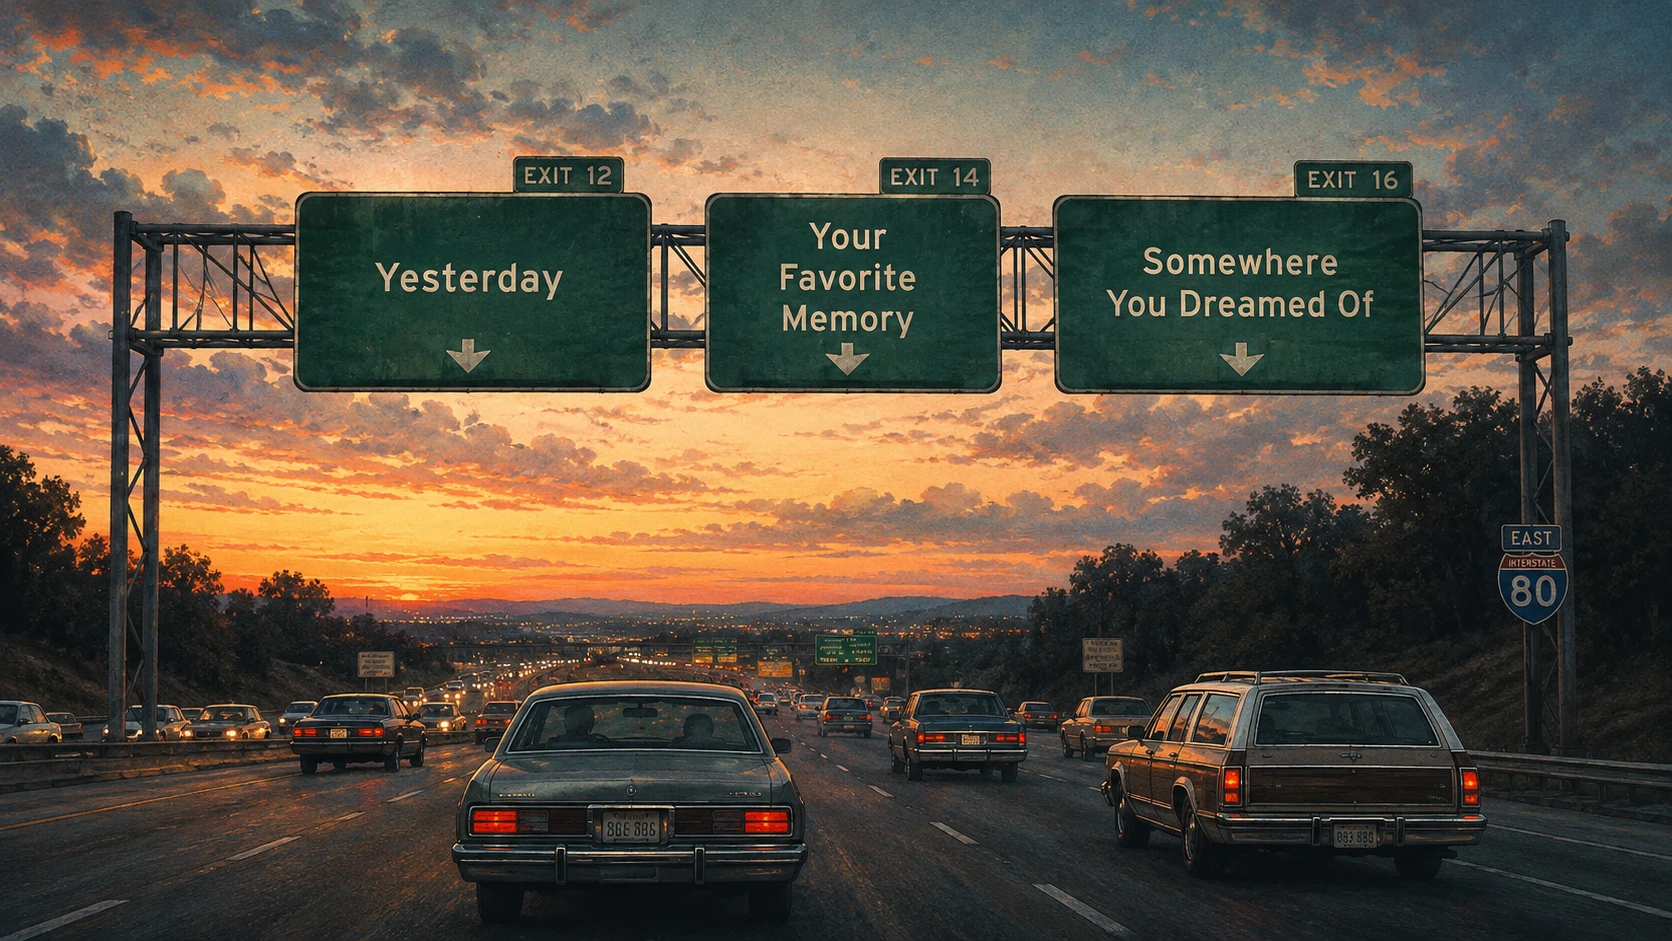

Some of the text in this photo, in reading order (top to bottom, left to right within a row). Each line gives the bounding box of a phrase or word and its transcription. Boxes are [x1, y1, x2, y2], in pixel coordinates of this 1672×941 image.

[525, 166, 611, 184] EXIT 12
[891, 168, 979, 186] EXIT 14
[1309, 170, 1398, 189] EXIT 16
[809, 223, 886, 249] Your
[1144, 247, 1337, 275] Somewhere
[375, 263, 563, 300] Yesterday
[781, 263, 915, 291] Favorite
[1107, 290, 1373, 317] You Dreamed Of
[783, 305, 913, 338] Memory
[1512, 531, 1551, 545] EAST
[1508, 559, 1557, 568] INTERSTATE
[1511, 575, 1556, 606] 80
